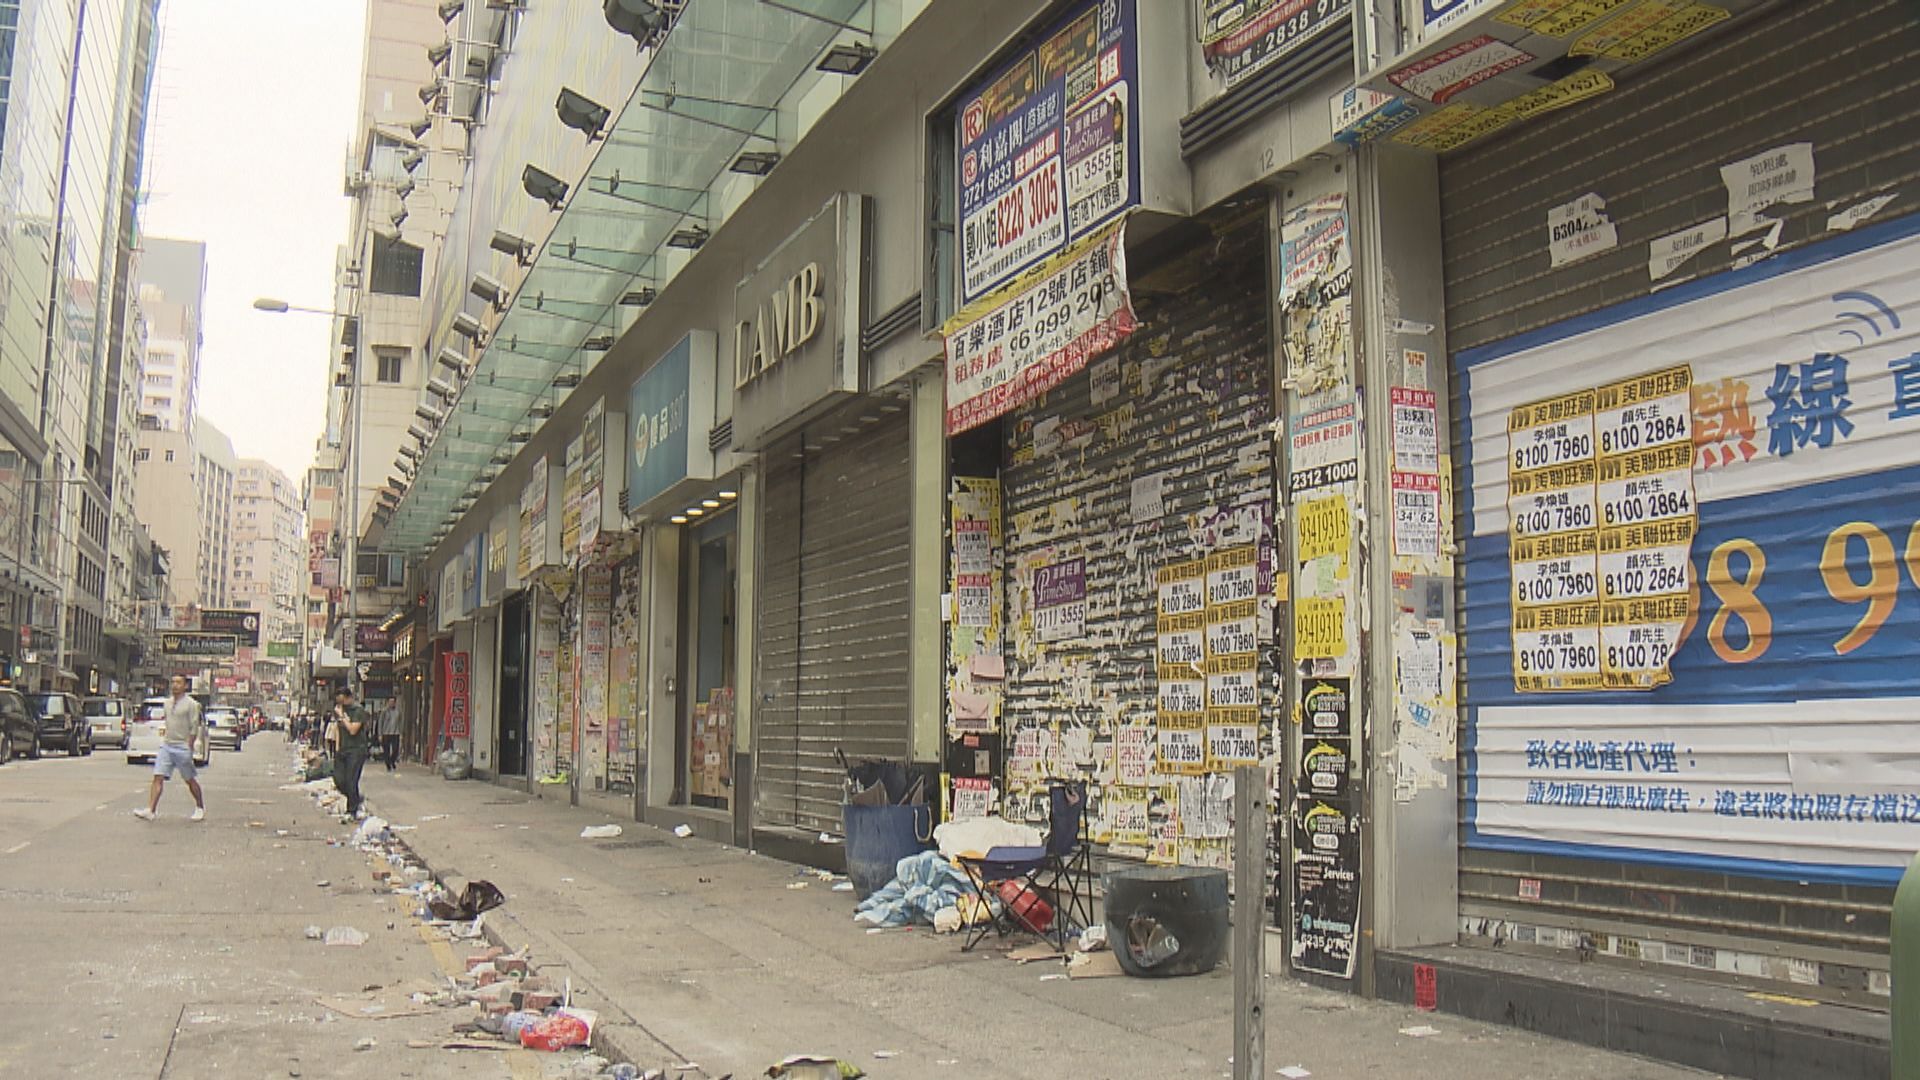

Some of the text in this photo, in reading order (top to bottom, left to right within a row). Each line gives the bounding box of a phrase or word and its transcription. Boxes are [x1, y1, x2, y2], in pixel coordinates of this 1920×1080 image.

[1266, 10, 1308, 52] 2838
[1317, 0, 1350, 19] 91
[979, 116, 1023, 173] 利嘉閣
[1084, 148, 1112, 180] 3555
[1260, 147, 1274, 173] 12
[964, 161, 1012, 209] 2721 6833
[997, 186, 1025, 249] 8228
[1028, 162, 1059, 229] 3005
[735, 261, 826, 391] LAMB
[1010, 329, 1030, 358] 96
[1035, 304, 1071, 341] 999
[1622, 371, 1689, 402] 美聯旺舖
[1534, 394, 1594, 423] 美聯旺舖
[1692, 352, 1854, 472] 熱線
[1602, 414, 1686, 453] 8100 2864
[1515, 434, 1589, 469] 8100 7960
[1625, 445, 1691, 474] 美聯旺舖
[1293, 462, 1356, 490] 2312 1000
[1534, 463, 1594, 490] 美聯旺舖
[1516, 503, 1591, 534] 8100 7960
[1605, 490, 1689, 524] 8100 2864
[1300, 508, 1346, 547] 93419313
[1626, 520, 1691, 547] 美聯旺舖
[1537, 532, 1598, 557] 美聯旺舖
[1036, 568, 1077, 602] PrimeShop
[1210, 578, 1254, 602] 8100 7960
[1518, 572, 1594, 601] 8100 7960
[1605, 565, 1685, 596] 8100 2864
[1060, 604, 1084, 625] 3555
[1162, 592, 1201, 613] 8100 2864
[1539, 606, 1599, 627] 美聯旺舖
[1628, 597, 1688, 622] 美聯旺舖
[1210, 632, 1254, 654] 8100 7960
[1297, 612, 1344, 645] 93419313
[1161, 643, 1201, 663] 8100 2864
[1520, 646, 1596, 672] 8100 7960
[1608, 641, 1673, 668] 8100 28
[1161, 695, 1201, 711] 8100 2864
[1211, 686, 1255, 705] 8100 7960
[1161, 743, 1201, 761] 8100 2864
[1211, 740, 1255, 757] 8100 7960
[1323, 866, 1354, 881] Services
